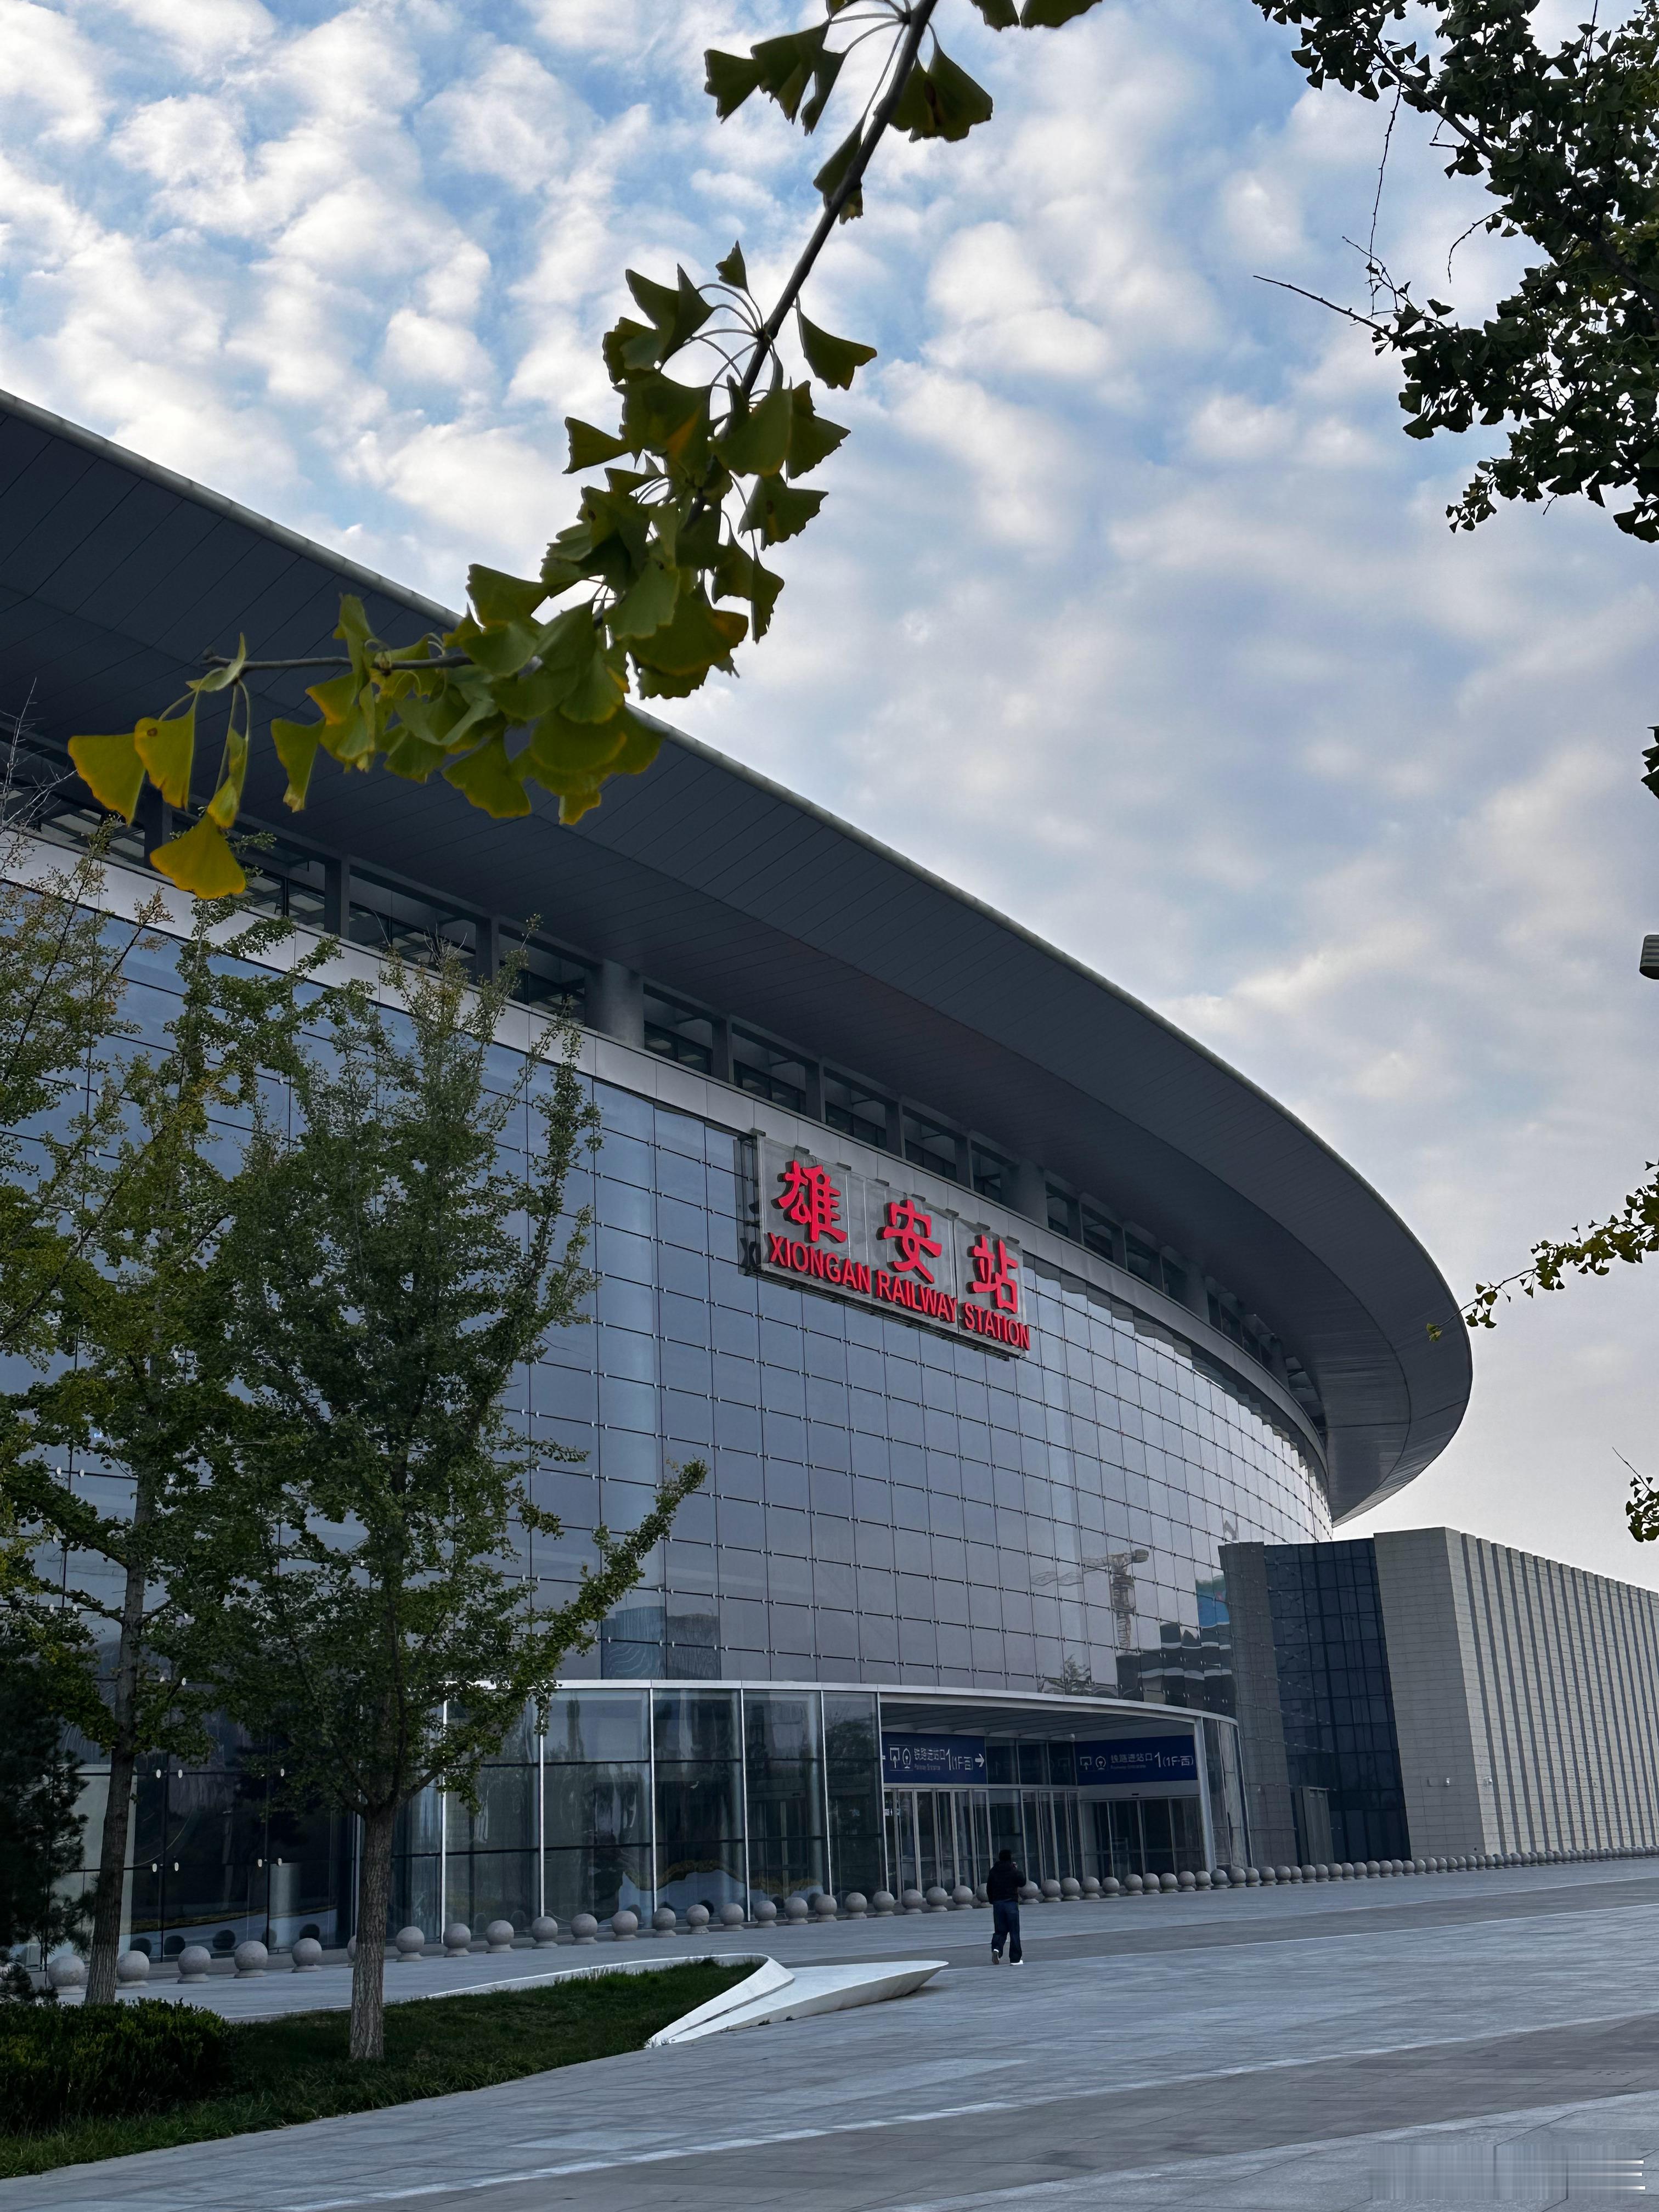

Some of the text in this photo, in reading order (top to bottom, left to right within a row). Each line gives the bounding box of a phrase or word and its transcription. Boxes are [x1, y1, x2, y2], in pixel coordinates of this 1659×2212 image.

[769, 1232, 1030, 1350] XIONGAN RAILWAY STATION
[778, 1160, 1019, 1314] 雄安站
